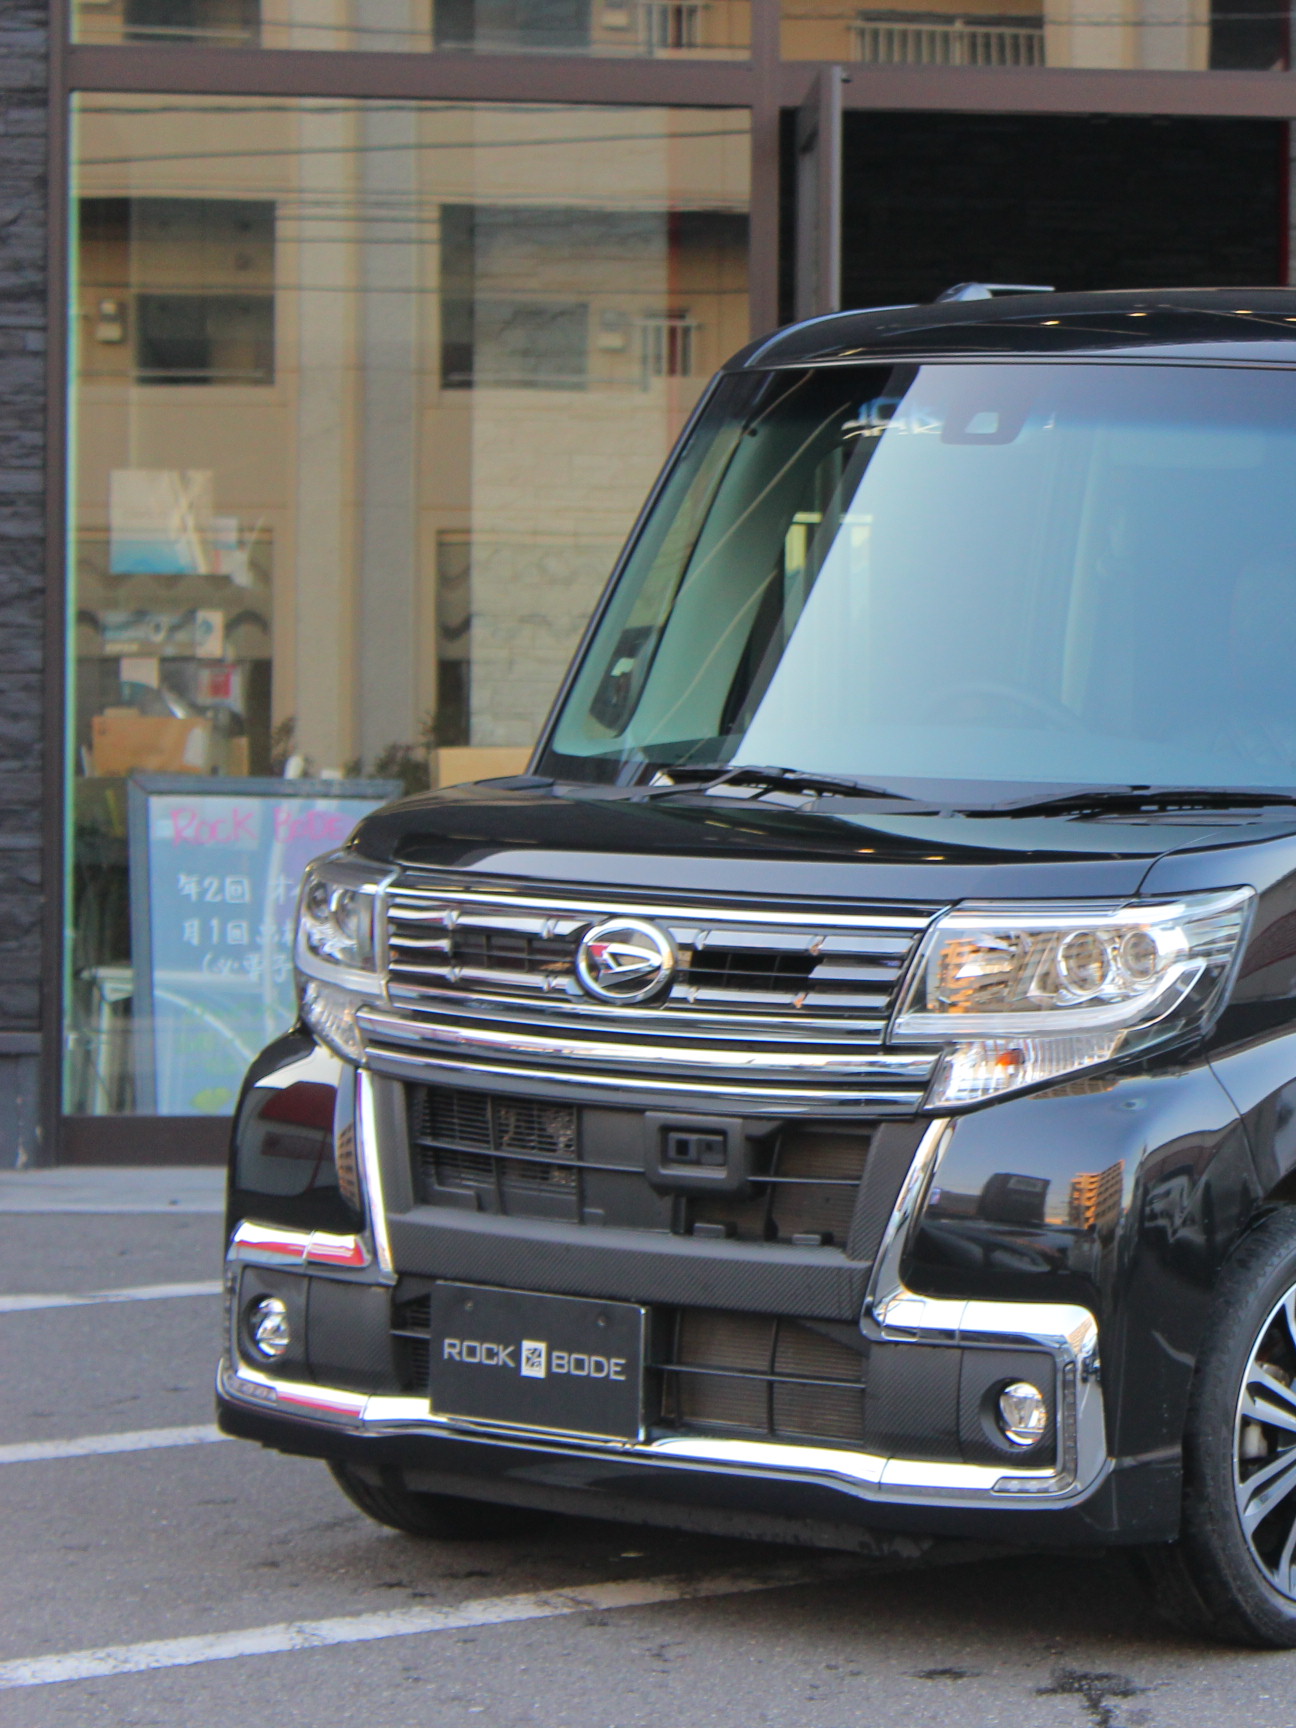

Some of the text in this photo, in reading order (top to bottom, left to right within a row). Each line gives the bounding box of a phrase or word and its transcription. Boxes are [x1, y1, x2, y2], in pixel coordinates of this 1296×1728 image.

[177, 873, 251, 904] 年2回
[182, 917, 250, 947] 月1回
[443, 1337, 627, 1381] ROCK BODE
